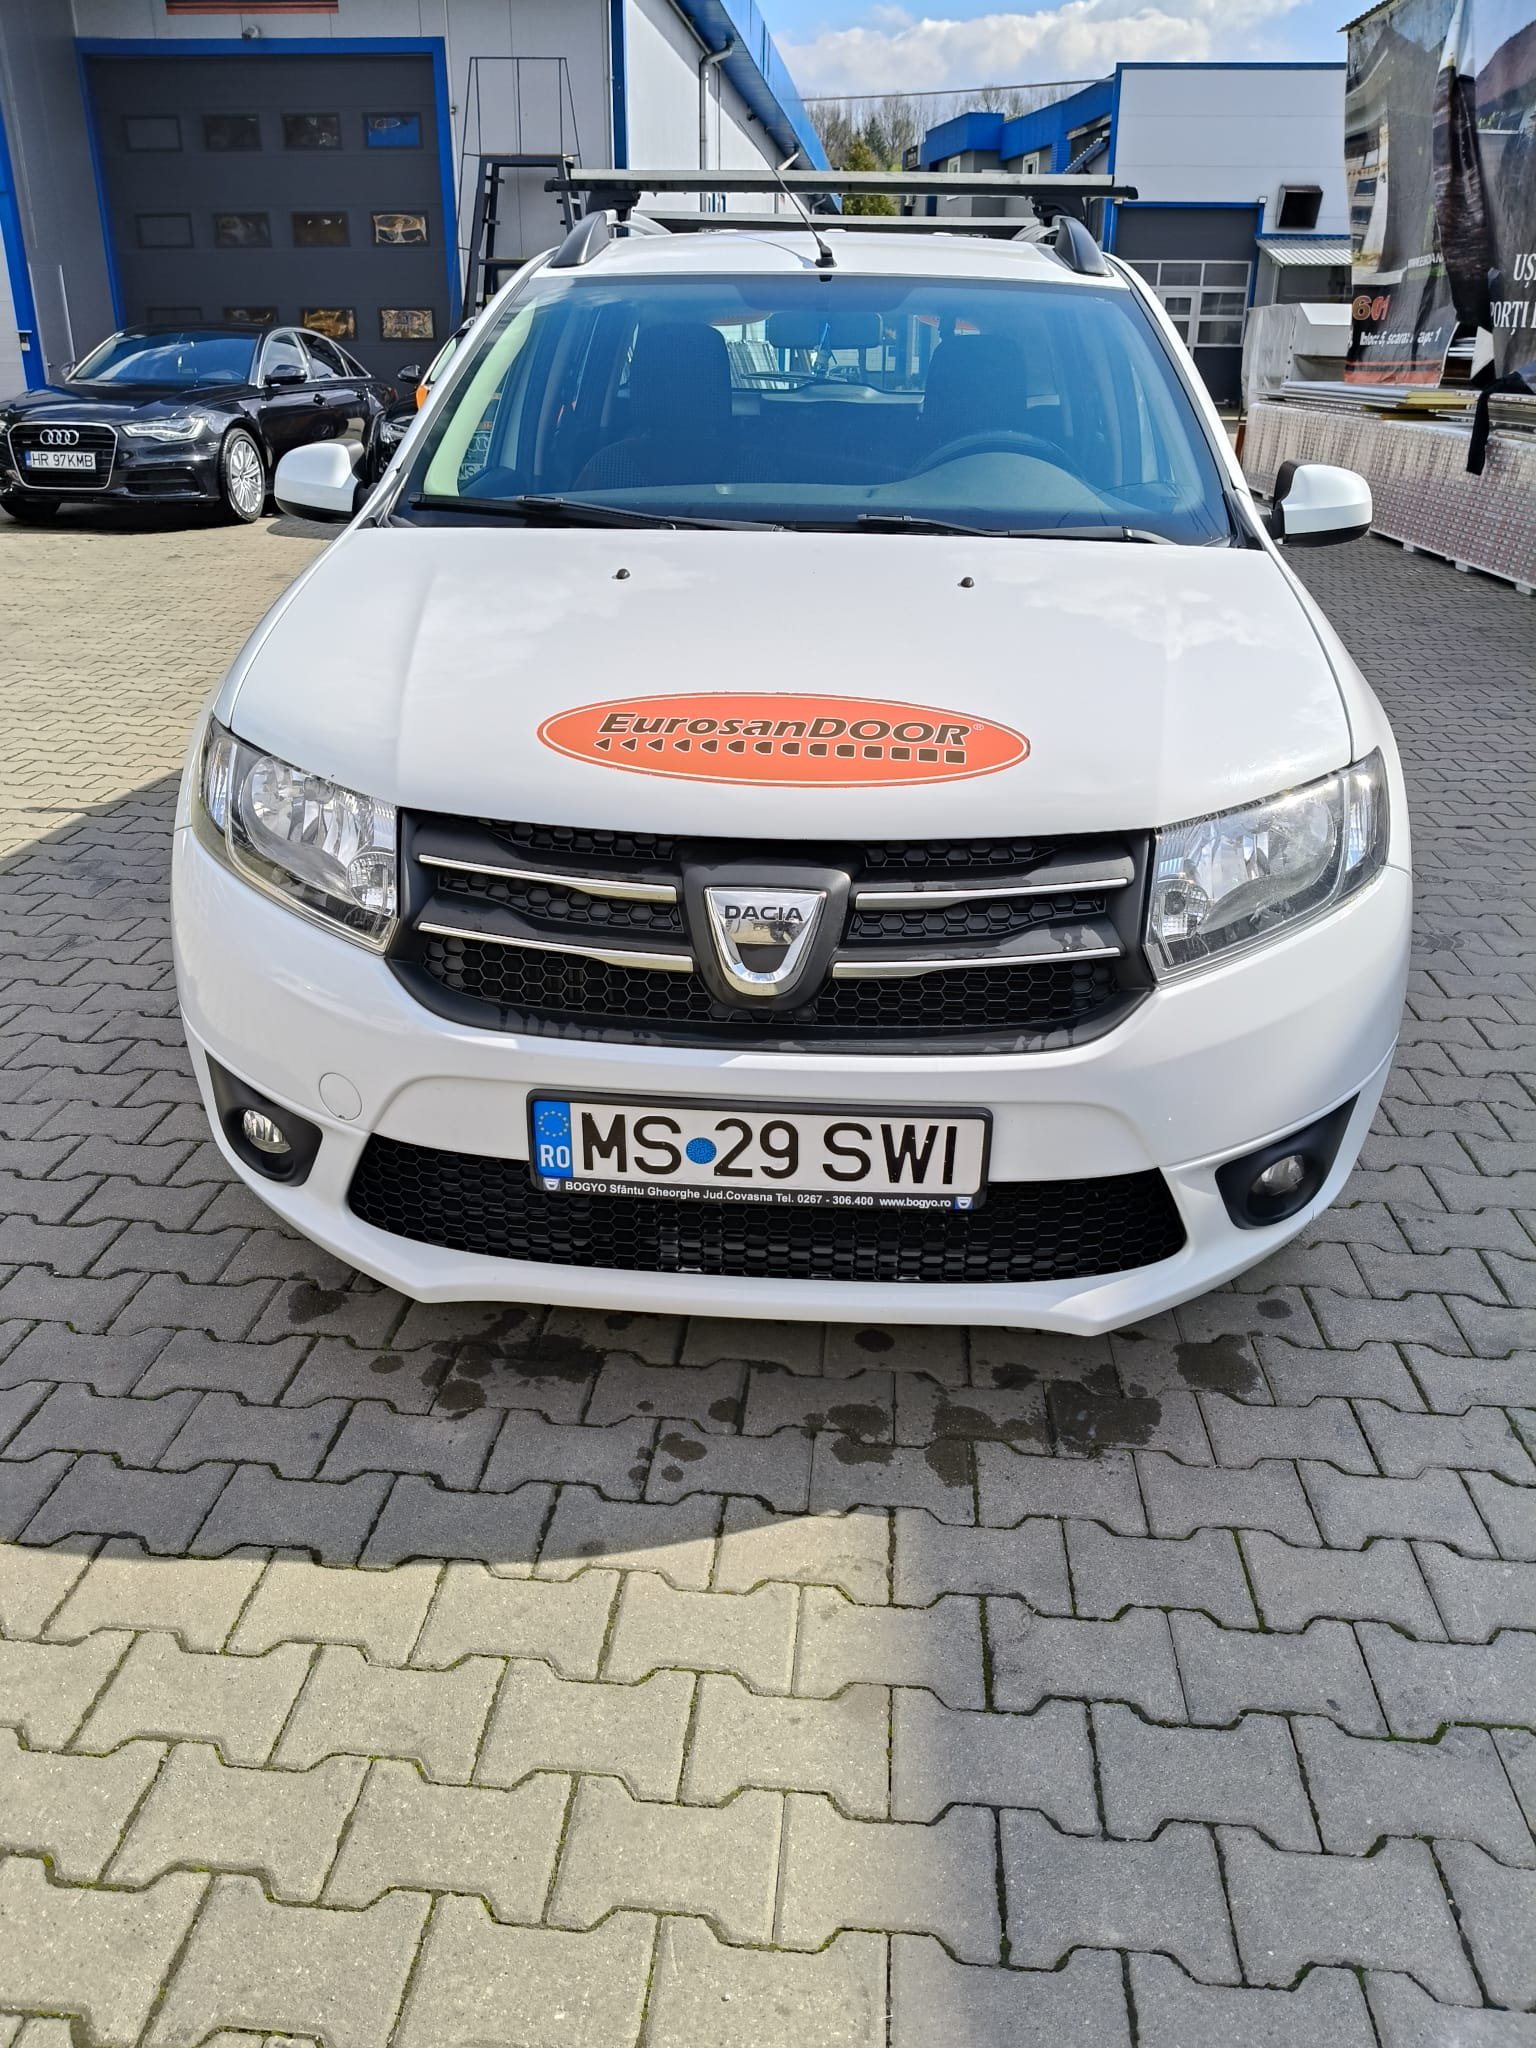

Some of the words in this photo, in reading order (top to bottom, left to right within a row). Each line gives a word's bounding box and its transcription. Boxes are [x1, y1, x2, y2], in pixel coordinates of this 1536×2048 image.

[32, 453, 49, 466] HR
[724, 905, 804, 922] DACIA
[540, 1144, 570, 1169] RO
[581, 1111, 683, 1175] MS
[713, 1117, 800, 1179] 29
[822, 1121, 959, 1185] SWI
[565, 1181, 607, 1193] BOGYO
[609, 1183, 645, 1196] Sfântu
[647, 1186, 700, 1200] Gheorghe
[702, 1189, 773, 1202] Jud.Covasna
[776, 1193, 794, 1203] Tel.
[797, 1193, 823, 1204] 0267
[832, 1195, 874, 1206] 306.400
[879, 1196, 951, 1209] www.bogyo.ro
